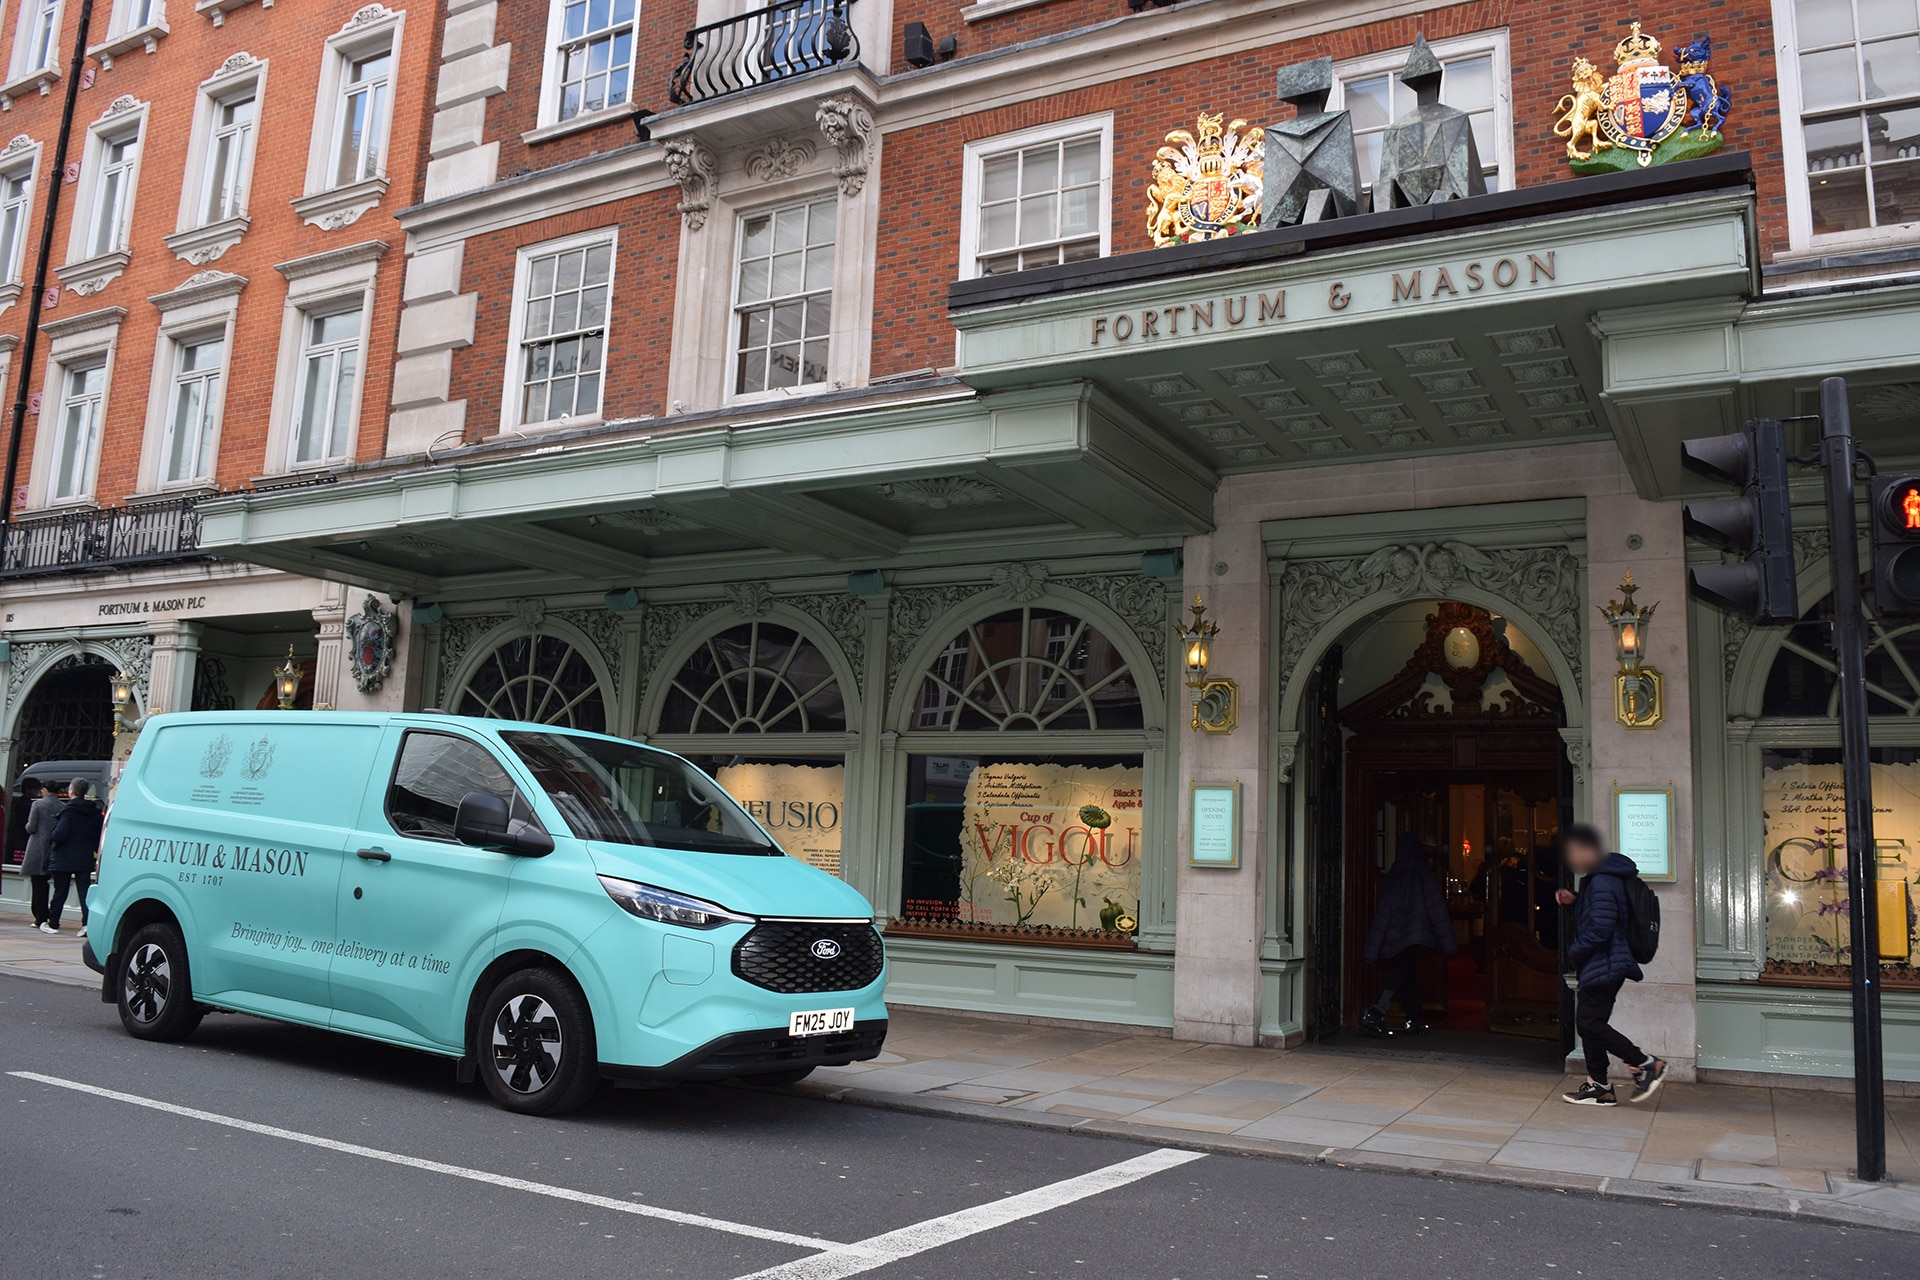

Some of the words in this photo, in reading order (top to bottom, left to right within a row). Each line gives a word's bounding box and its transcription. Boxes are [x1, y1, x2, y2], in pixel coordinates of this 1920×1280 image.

[1091, 290, 1286, 344] FORTNUM
[1328, 281, 1351, 310] &
[1392, 251, 1555, 301] MASON
[98, 602, 141, 616] FORTNUM
[142, 602, 149, 612] &
[152, 598, 185, 612] MASON
[187, 596, 206, 609] PLC
[1114, 789, 1136, 797] Black
[1137, 789, 1143, 797] T
[1790, 782, 1817, 790] Salvia
[1112, 800, 1136, 810] Apple
[1826, 794, 1846, 802] Pipe
[742, 801, 843, 829] FUSIO
[1020, 812, 1040, 822] Cup
[1042, 812, 1055, 824] of
[976, 824, 1142, 867] VIGOU
[118, 836, 210, 867] FORTNUM
[212, 844, 227, 869] &
[230, 846, 309, 877] MASON
[1775, 837, 1920, 884] CLE
[178, 872, 197, 883] EST
[202, 875, 224, 886] 1707
[231, 922, 282, 948] Bringing
[282, 930, 306, 952] joy...
[311, 938, 334, 954] one
[335, 938, 388, 967] delivery
[390, 950, 406, 967] at
[408, 954, 418, 969] a
[421, 953, 451, 974] time
[816, 941, 836, 956] Ford
[795, 1013, 826, 1032] FM25
[828, 1011, 850, 1029] JOY
